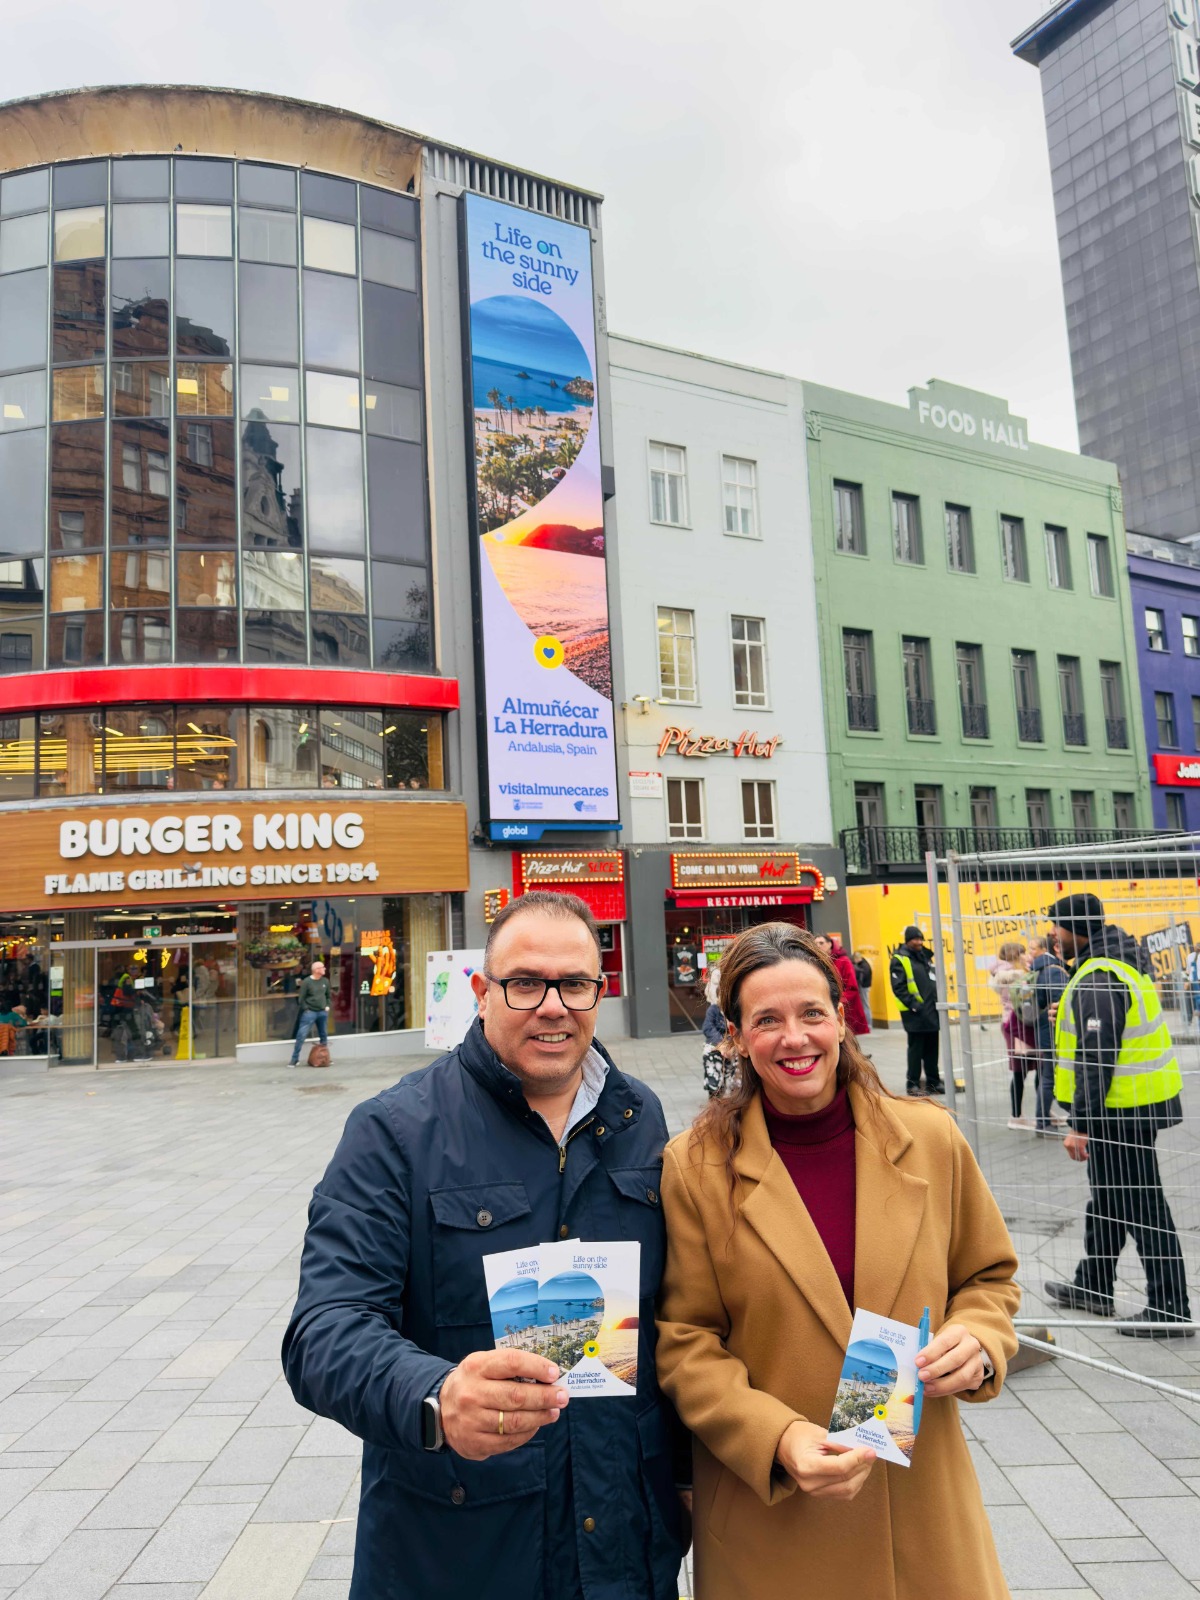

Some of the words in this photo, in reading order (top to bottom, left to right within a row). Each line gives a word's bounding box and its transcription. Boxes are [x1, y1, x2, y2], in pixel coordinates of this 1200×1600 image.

[494, 222, 532, 250] Life
[536, 239, 563, 260] on
[481, 240, 515, 265] the
[519, 256, 579, 287] sunny
[512, 271, 552, 295] side
[918, 400, 977, 437] FOOD
[982, 419, 1028, 450] HALL
[502, 697, 600, 719] Almuñécar
[494, 717, 517, 734] La
[520, 718, 609, 739] Herradura
[508, 740, 566, 755] Andalusia,
[566, 743, 598, 757] Spain
[657, 726, 731, 759] Pizza
[731, 729, 785, 759] Hut
[498, 782, 609, 797] visitalmunecar.es
[59, 814, 244, 860] BURGER
[253, 812, 365, 851] KING
[502, 825, 529, 839] global
[527, 860, 560, 876] Pizza
[561, 860, 584, 875] Hut
[587, 861, 616, 873] SLICE
[680, 865, 703, 875] COME
[704, 865, 716, 875] ON
[717, 864, 726, 874] IN
[726, 864, 737, 874] TO
[738, 864, 758, 875] YOUR
[759, 860, 792, 878] Hut
[44, 872, 125, 896] FLAME
[127, 865, 247, 891] GRILLING
[250, 863, 323, 886] SINCE
[325, 861, 380, 884] 1954
[707, 896, 783, 907] RESTAURANT
[974, 893, 1011, 916] HELLO
[516, 1261, 529, 1269] Life
[517, 1267, 537, 1276] sunny
[879, 1333, 894, 1343] sunny
[568, 1371, 602, 1379] Almuñécar
[862, 1433, 888, 1446] Herradura
